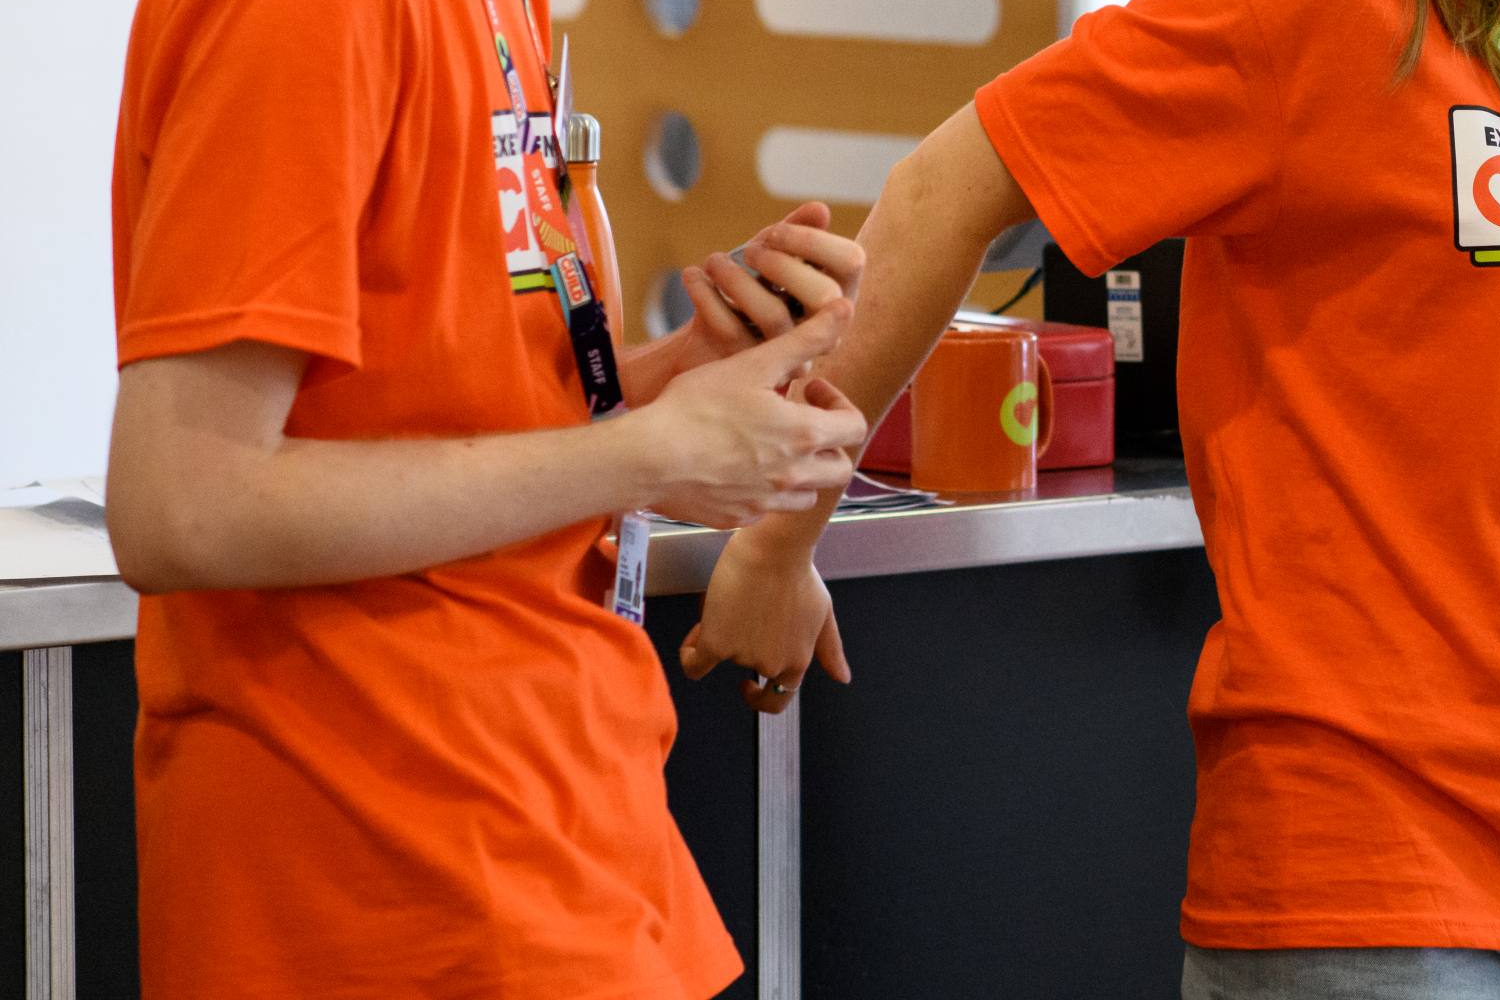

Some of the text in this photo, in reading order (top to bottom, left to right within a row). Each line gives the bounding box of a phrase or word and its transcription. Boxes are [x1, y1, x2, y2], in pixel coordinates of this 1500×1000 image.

[531, 168, 553, 211] STAFF
[561, 257, 585, 303] GUILD
[587, 348, 607, 385] STAFF
